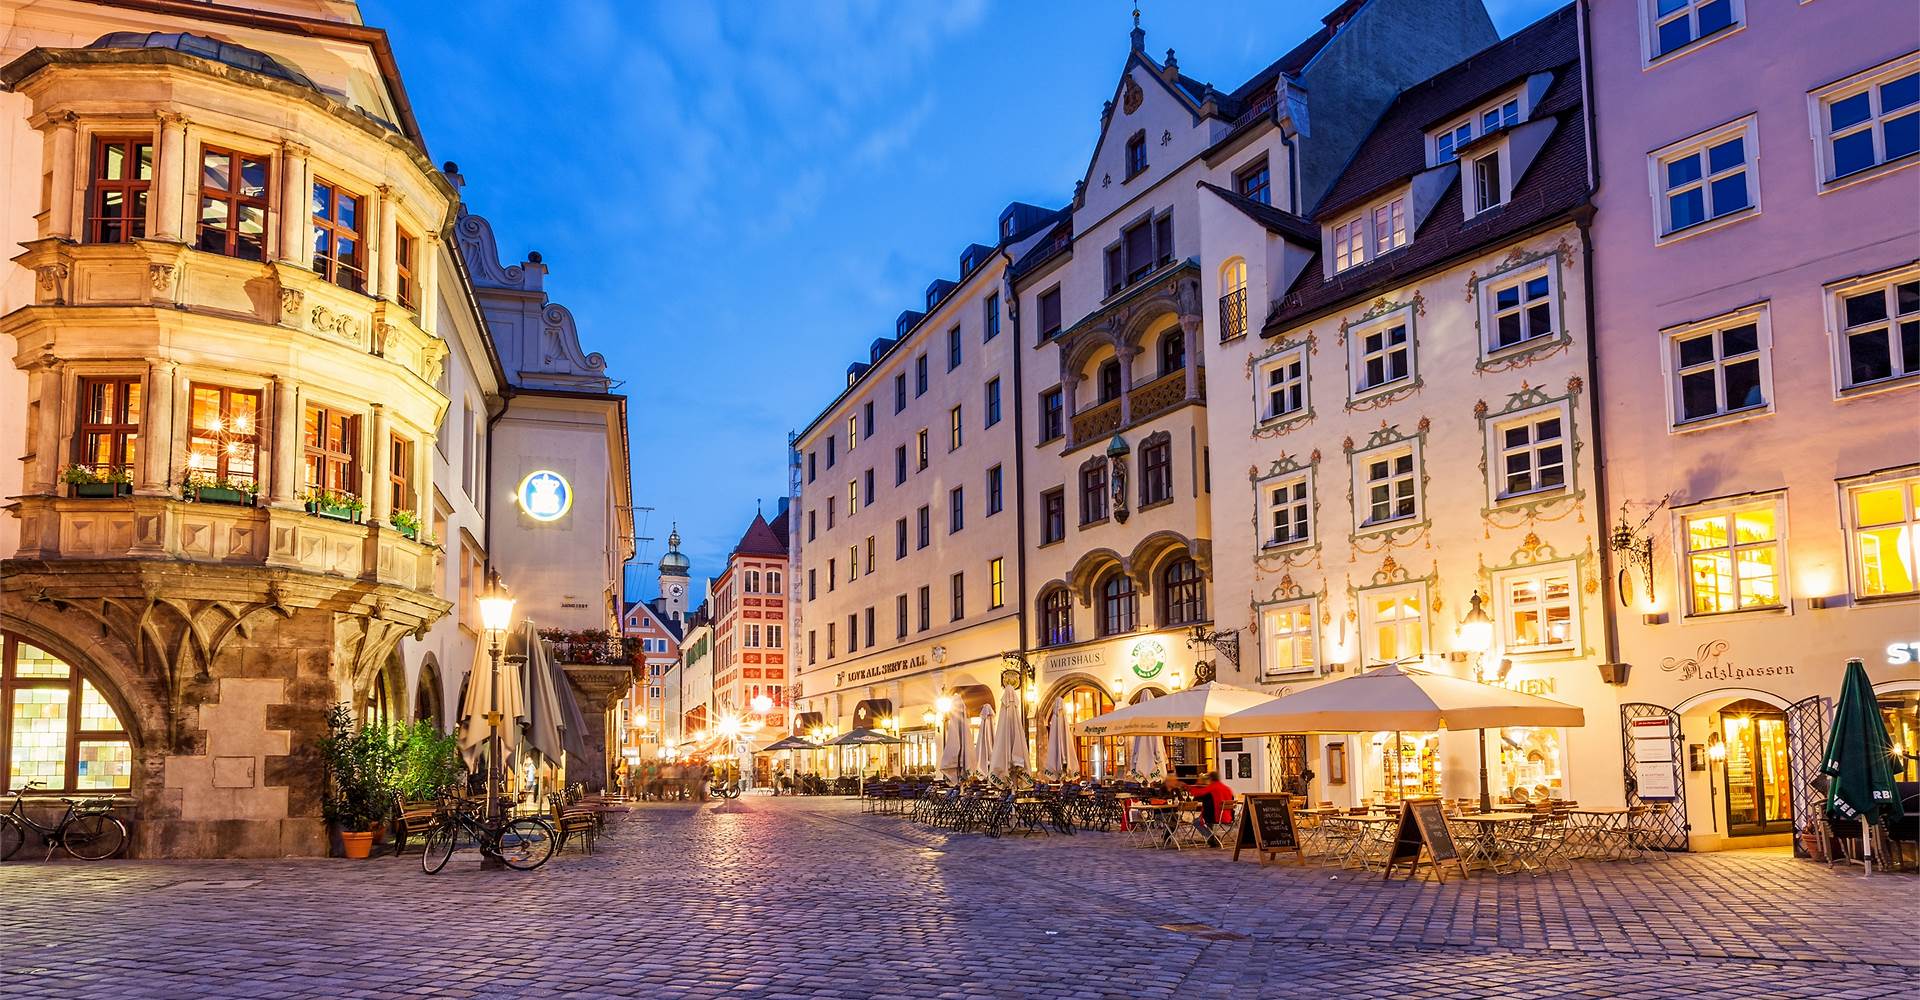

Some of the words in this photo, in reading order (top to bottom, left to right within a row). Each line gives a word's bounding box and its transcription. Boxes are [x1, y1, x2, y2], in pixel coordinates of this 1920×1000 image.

[1050, 652, 1100, 668] WIRTSHAUS
[847, 669, 866, 682] LOVE
[866, 666, 881, 679] ALL
[882, 659, 908, 674] SERVE
[909, 654, 927, 669] ALL
[1660, 655, 1795, 681] Platzlgassen
[1084, 726, 1107, 735] Ayinger
[1167, 720, 1190, 731] Ayinger
[1872, 790, 1893, 800] RB
